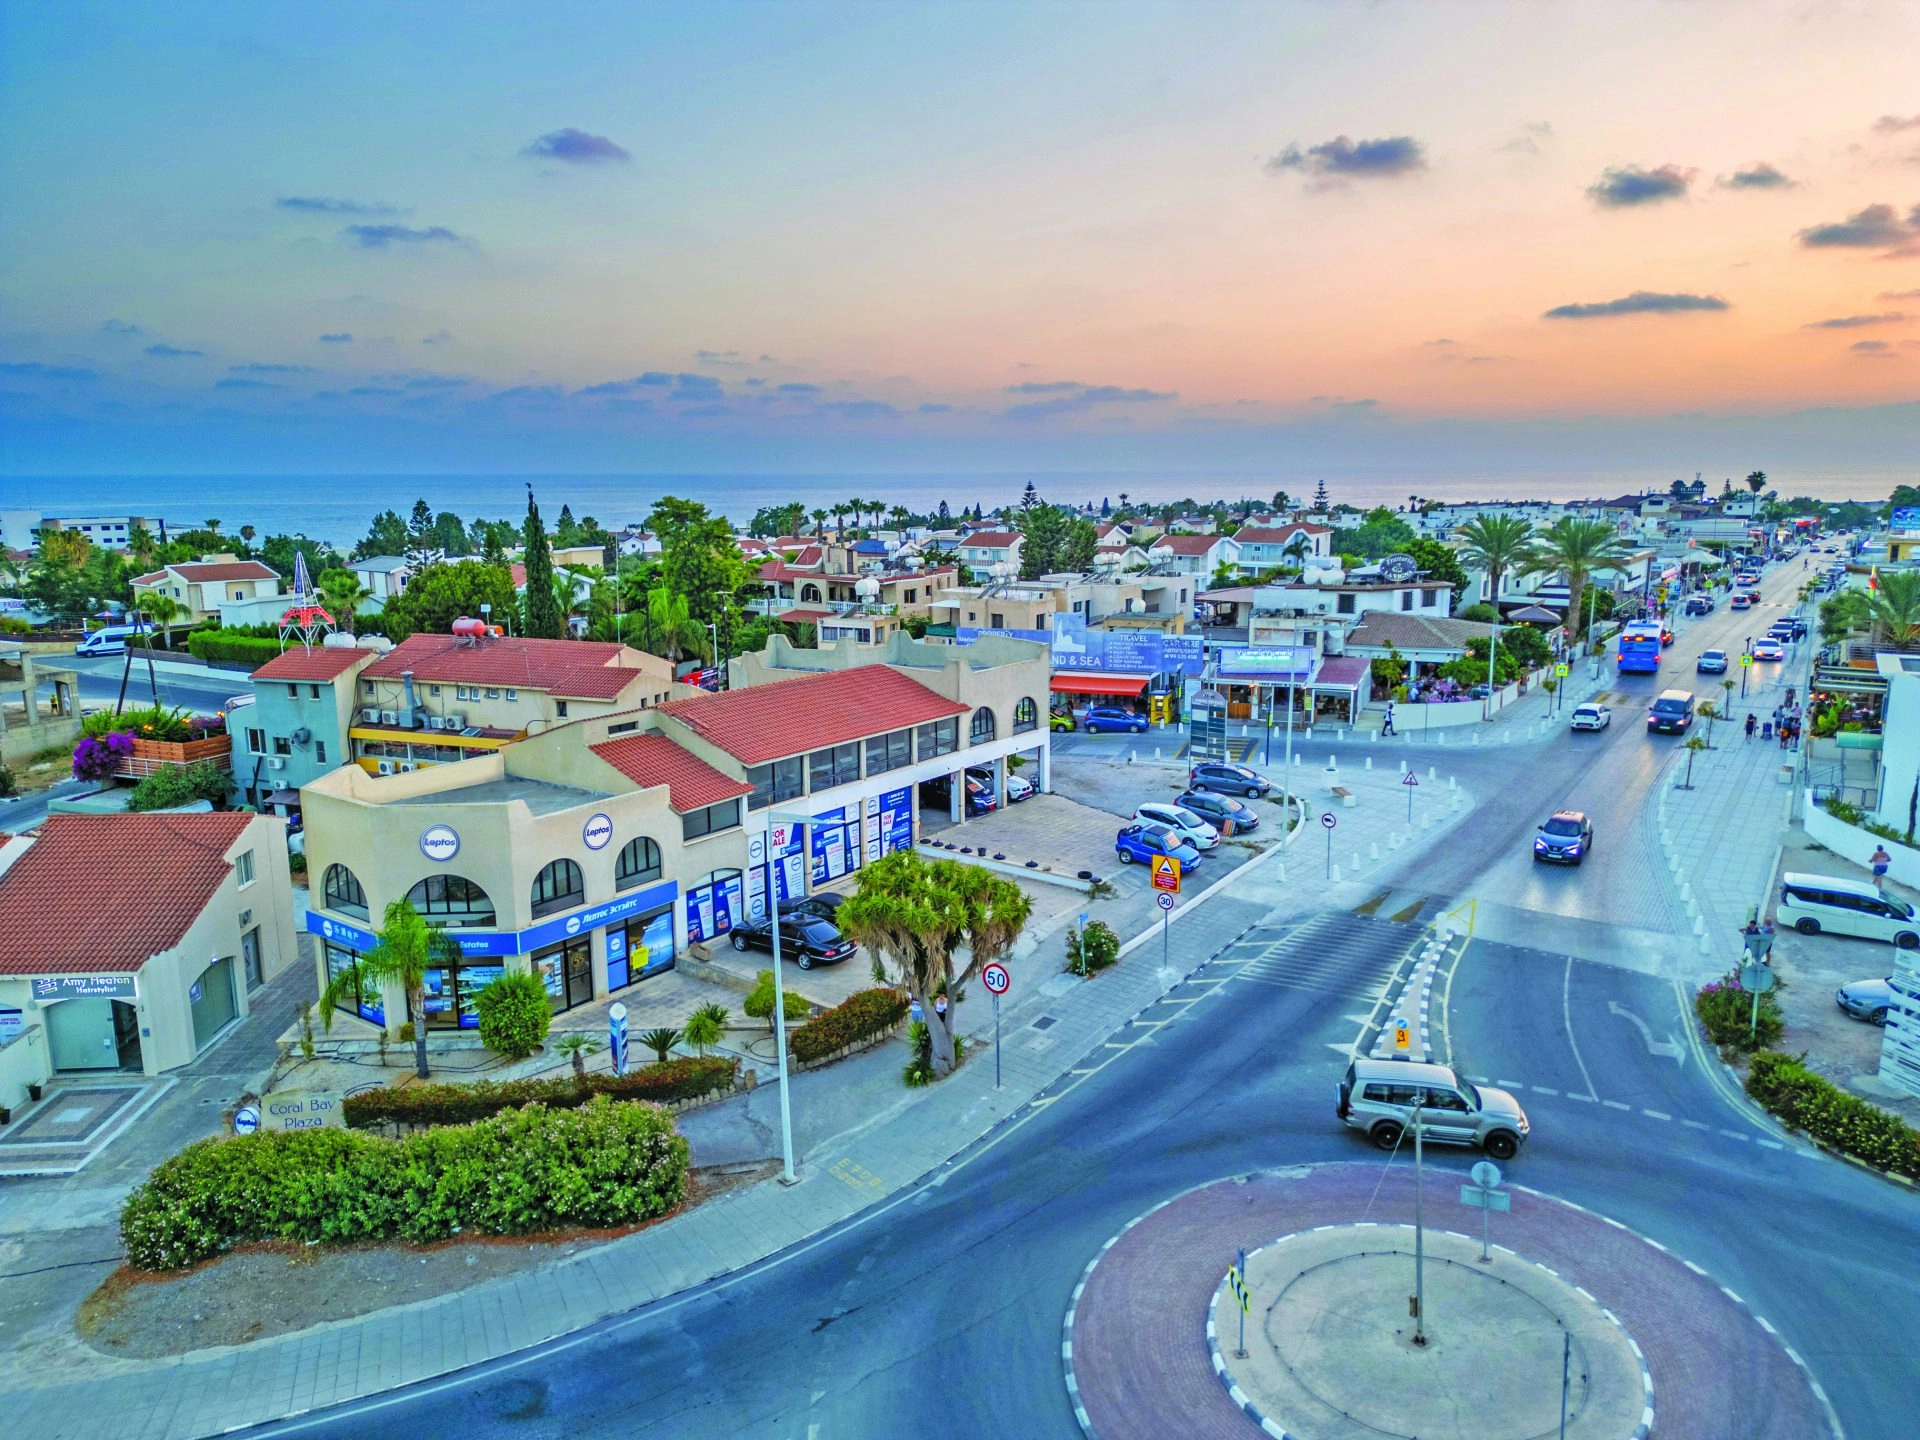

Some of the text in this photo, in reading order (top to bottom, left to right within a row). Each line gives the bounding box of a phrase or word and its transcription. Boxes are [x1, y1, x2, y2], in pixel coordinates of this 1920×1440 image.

[1119, 634, 1148, 642] TRAVEL
[1162, 639, 1200, 648] CAR HIRE
[1050, 655, 1101, 667] ND & SEA
[586, 825, 610, 838] Leptos
[424, 837, 456, 848] Leptos
[1160, 896, 1171, 906] 30
[460, 941, 489, 949] Estates
[62, 976, 130, 988] Amy Heaton
[987, 971, 1005, 988] 50
[76, 986, 117, 994] Hairstylist
[269, 1101, 304, 1116] Coral
[310, 1099, 337, 1113] Bay
[284, 1116, 322, 1129] Plaza
